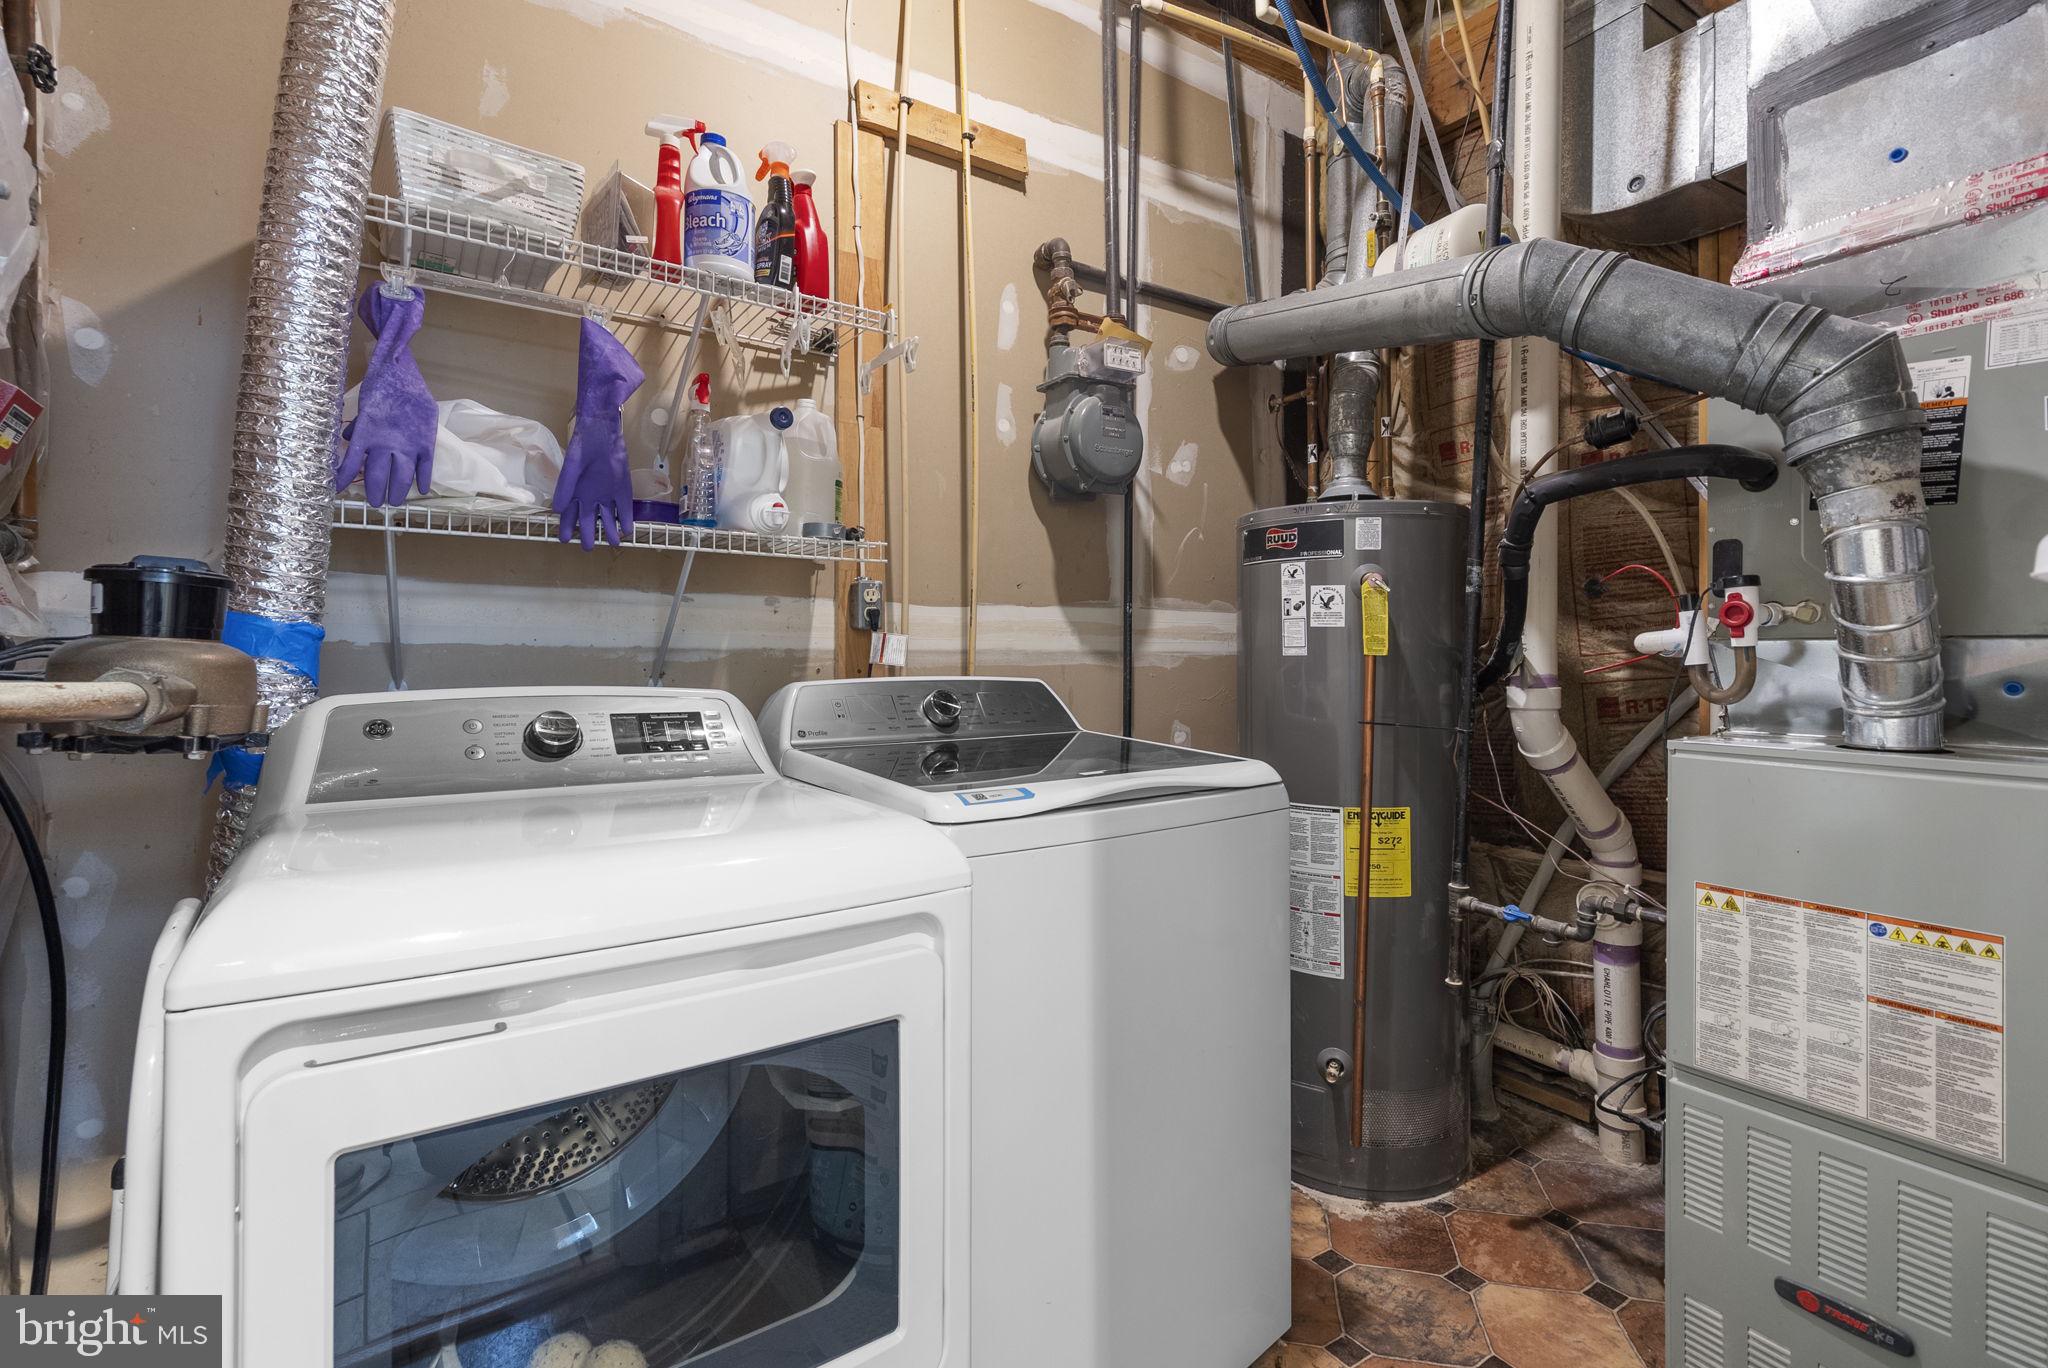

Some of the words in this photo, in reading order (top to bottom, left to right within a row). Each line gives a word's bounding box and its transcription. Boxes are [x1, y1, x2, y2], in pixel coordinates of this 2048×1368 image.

[1929, 293, 1968, 307] 181B-FX
[1930, 302, 1980, 318] Shurtape
[1985, 295, 2001, 307] SF
[2003, 290, 2025, 301] 686
[1924, 319, 1965, 333] 181B-FX
[1267, 533, 1297, 545] RUUD
[1300, 549, 1343, 557] PROFESSIONAL
[1347, 811, 1406, 820] ENGYGUIDE
[1378, 836, 1402, 845] $272
[1709, 886, 1734, 895] WARNING
[1920, 923, 1953, 934] WARNING
[1604, 1010, 1612, 1025] PIPE
[1823, 1304, 1869, 1333] TRANE
